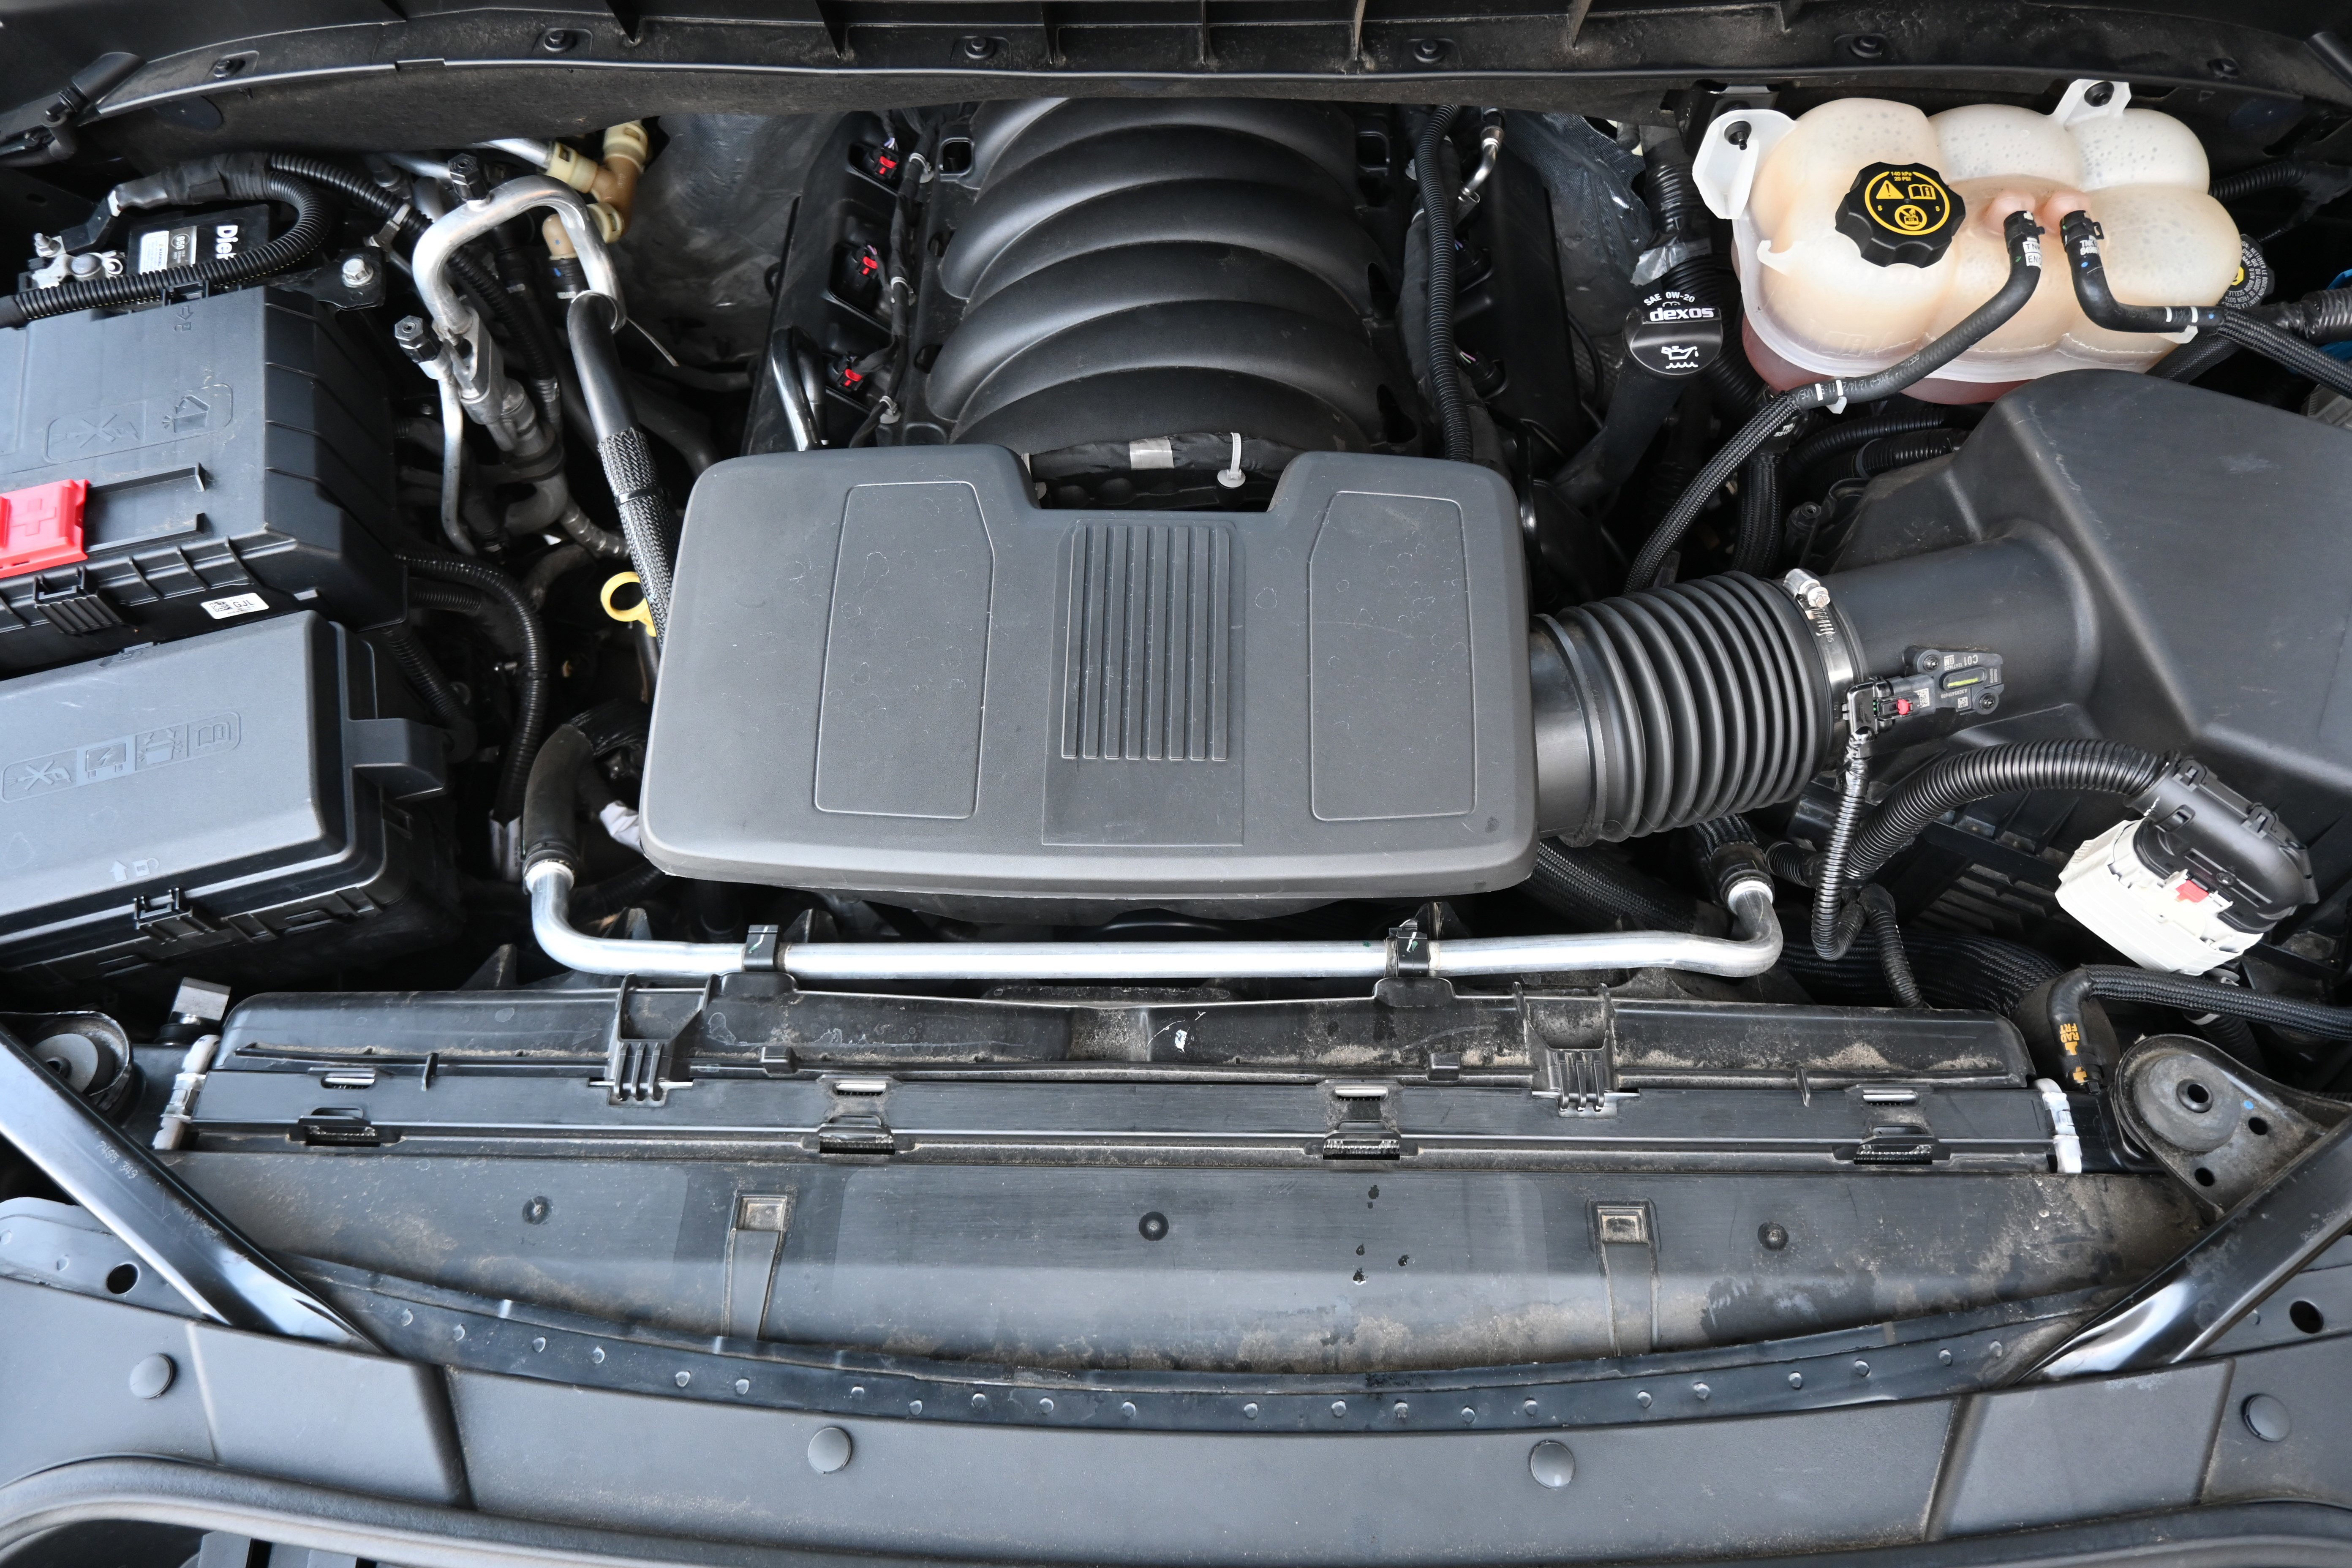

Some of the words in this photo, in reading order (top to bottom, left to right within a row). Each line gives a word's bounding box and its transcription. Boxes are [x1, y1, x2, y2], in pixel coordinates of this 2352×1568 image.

[176, 236, 185, 250] 850
[1644, 294, 1662, 306] SAE
[233, 599, 255, 608] GJL
[1944, 656, 1955, 667] GM
[2060, 1023, 2077, 1034] FRT
[2061, 1032, 2080, 1043] RAD
